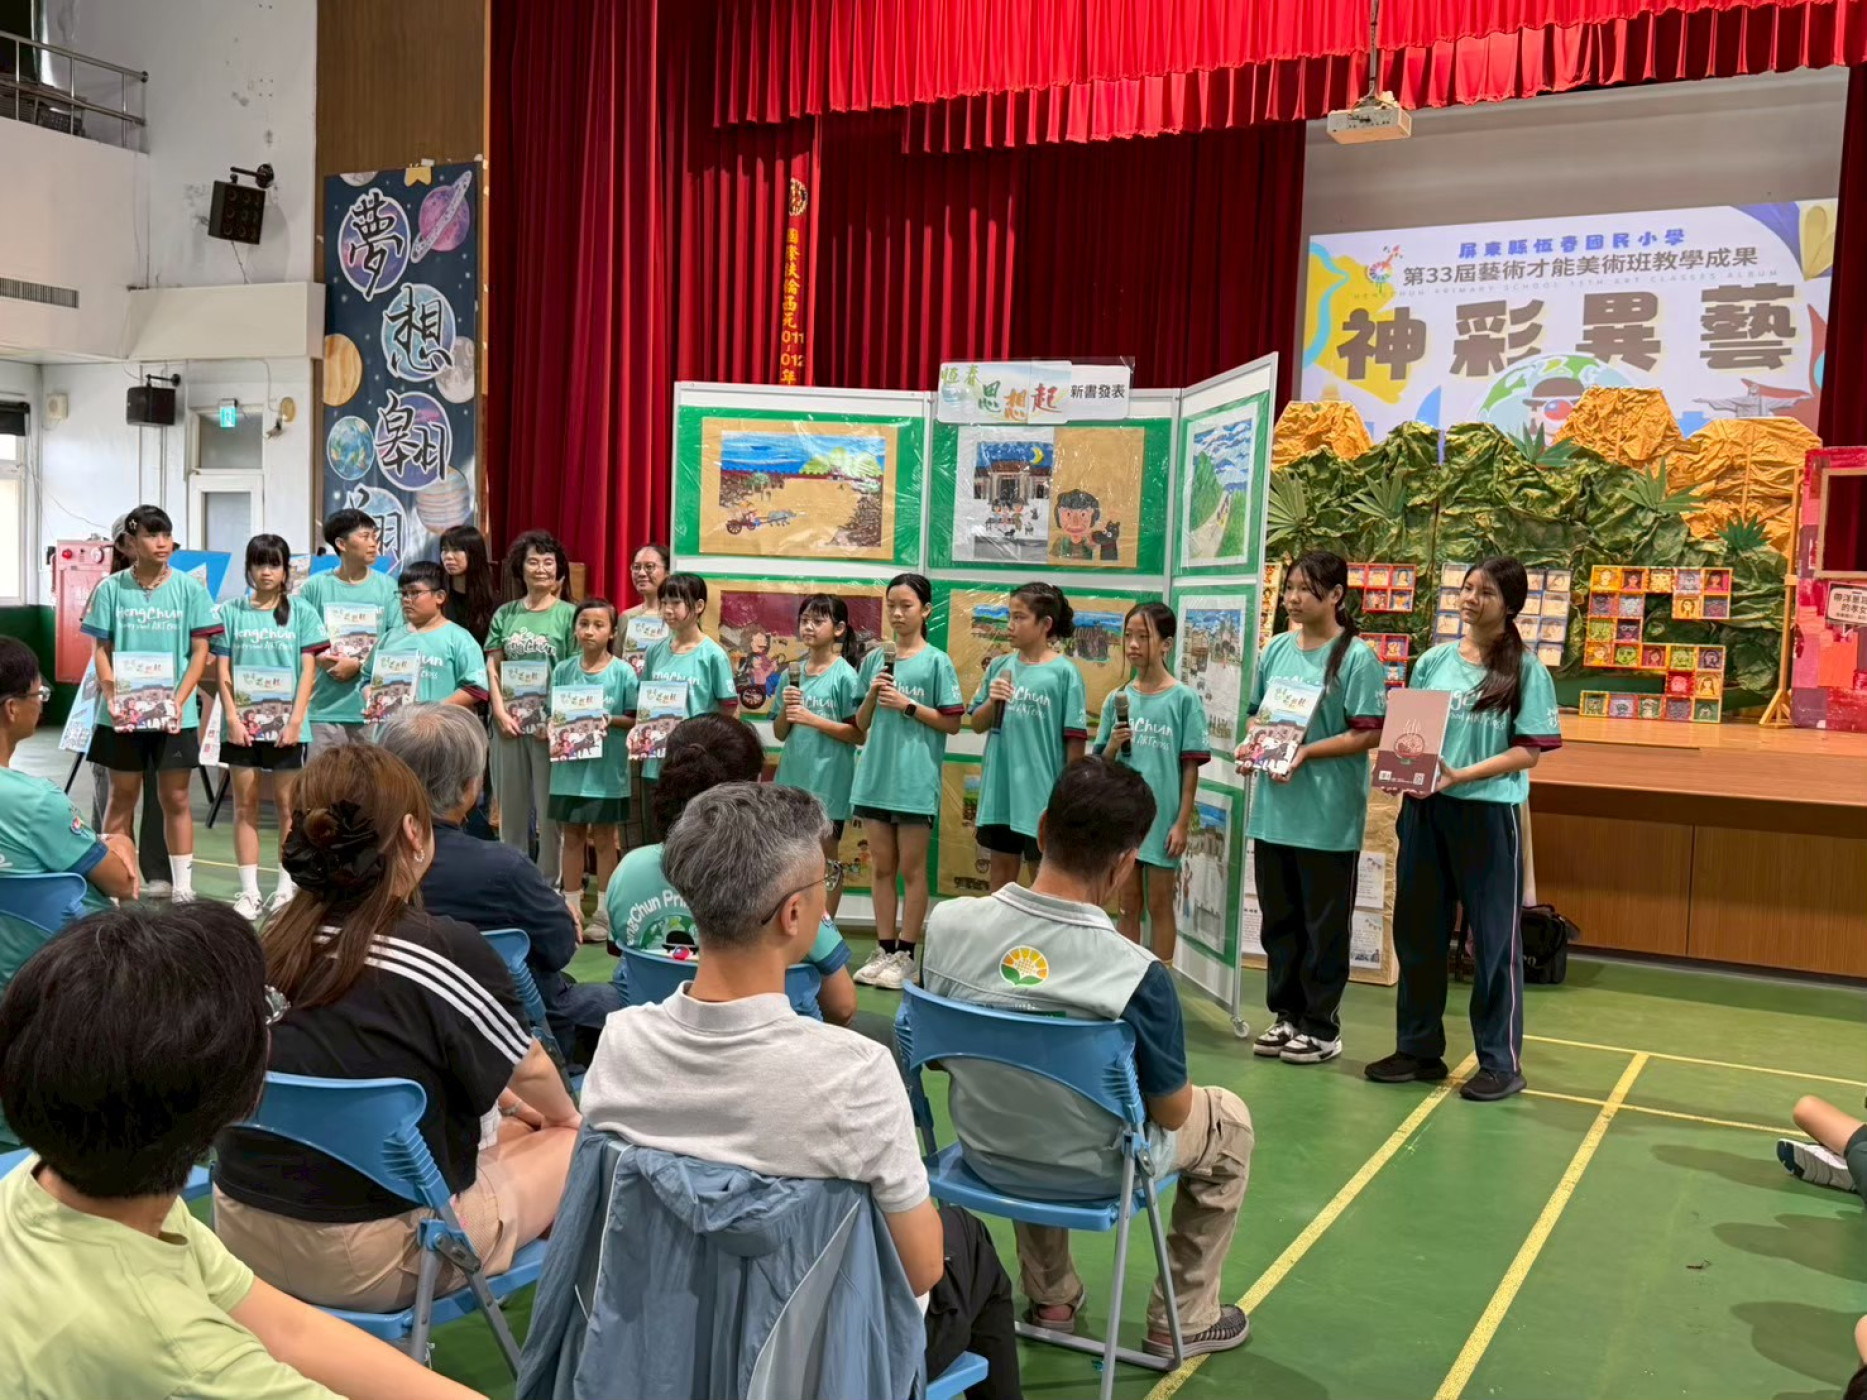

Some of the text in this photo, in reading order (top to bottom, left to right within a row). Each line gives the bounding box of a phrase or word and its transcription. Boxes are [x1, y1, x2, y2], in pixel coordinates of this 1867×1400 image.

[1403, 246, 1758, 286] 第33屆藝術才能美術班教學成果
[1338, 282, 1798, 381] 神彩異藝
[1070, 383, 1125, 399] 新書發表
